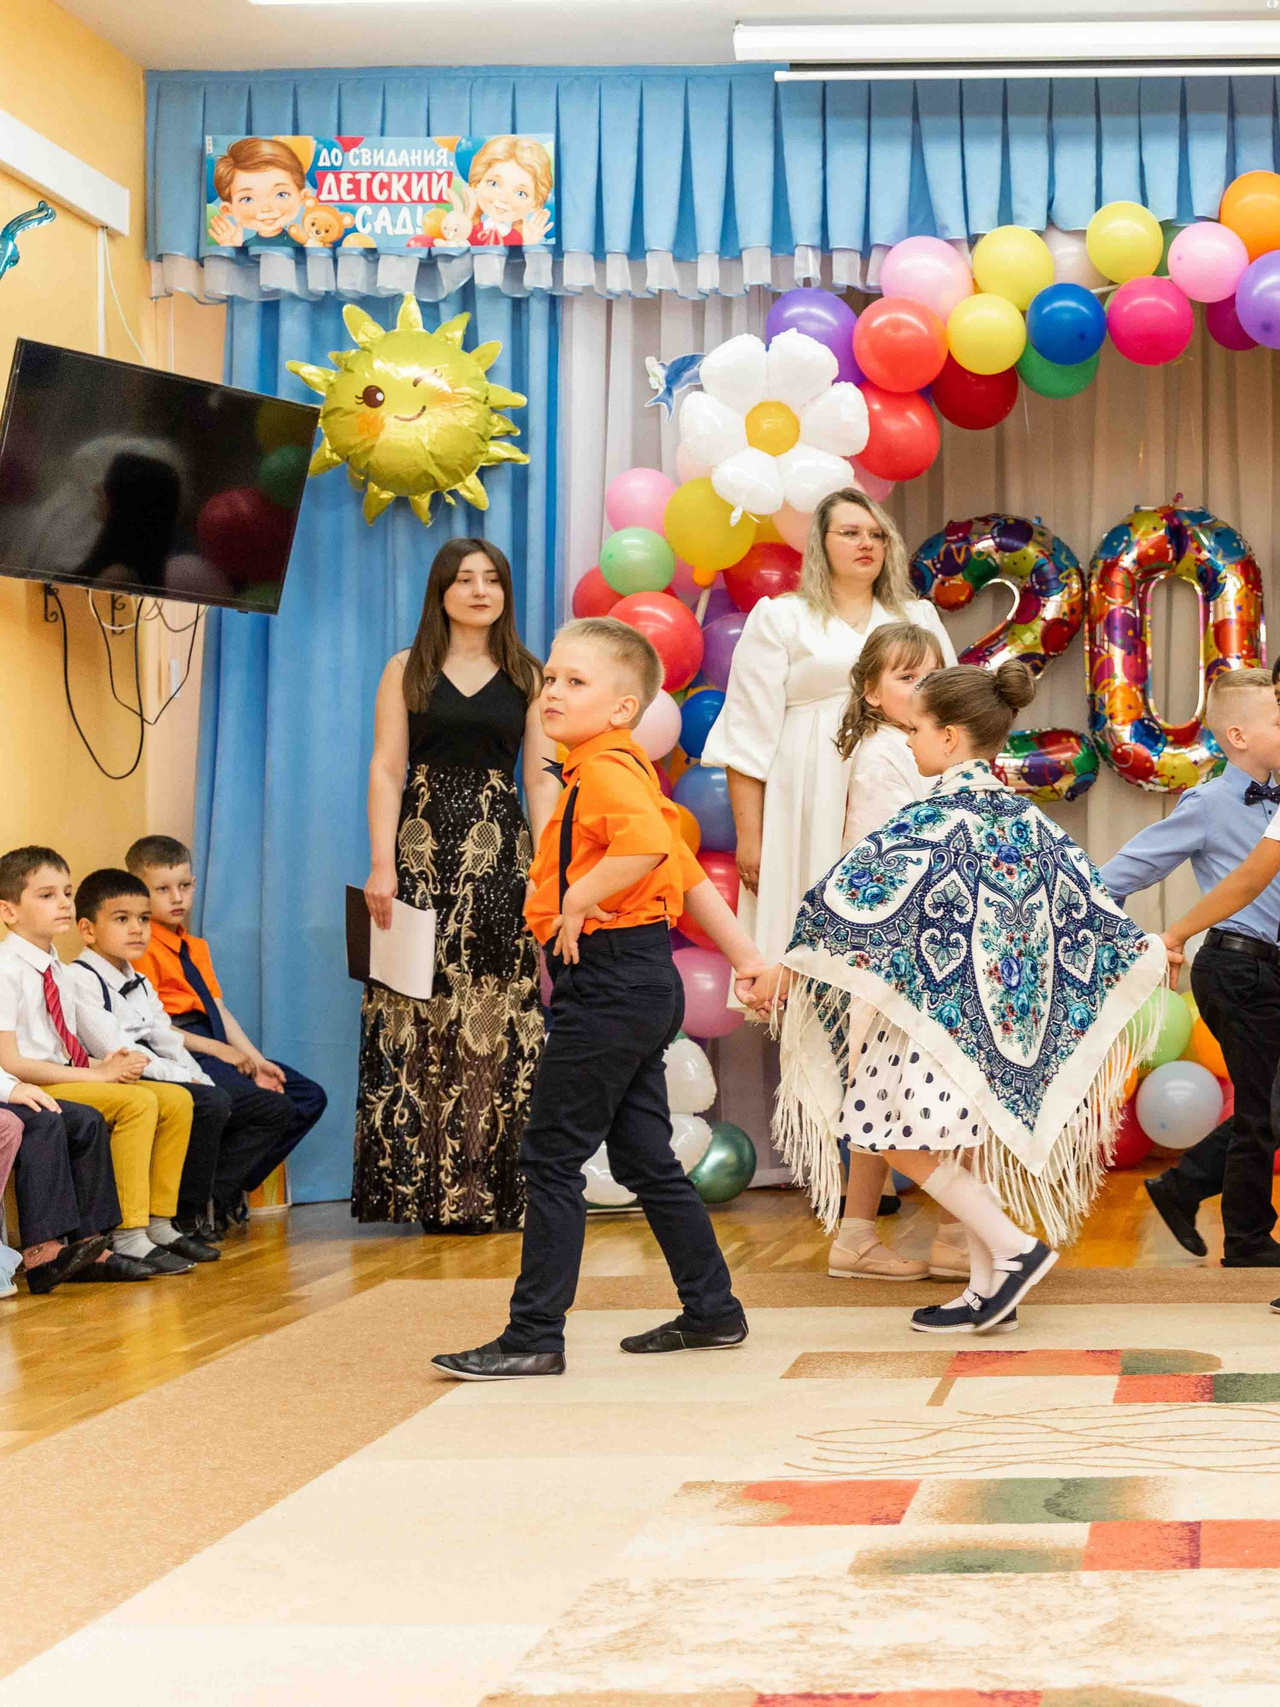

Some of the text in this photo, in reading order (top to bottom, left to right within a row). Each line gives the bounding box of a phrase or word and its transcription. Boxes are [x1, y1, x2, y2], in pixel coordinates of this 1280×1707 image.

[317, 148, 343, 166] ДО
[318, 169, 449, 202] ДЕТСКИЙ
[355, 205, 423, 235] САД!
